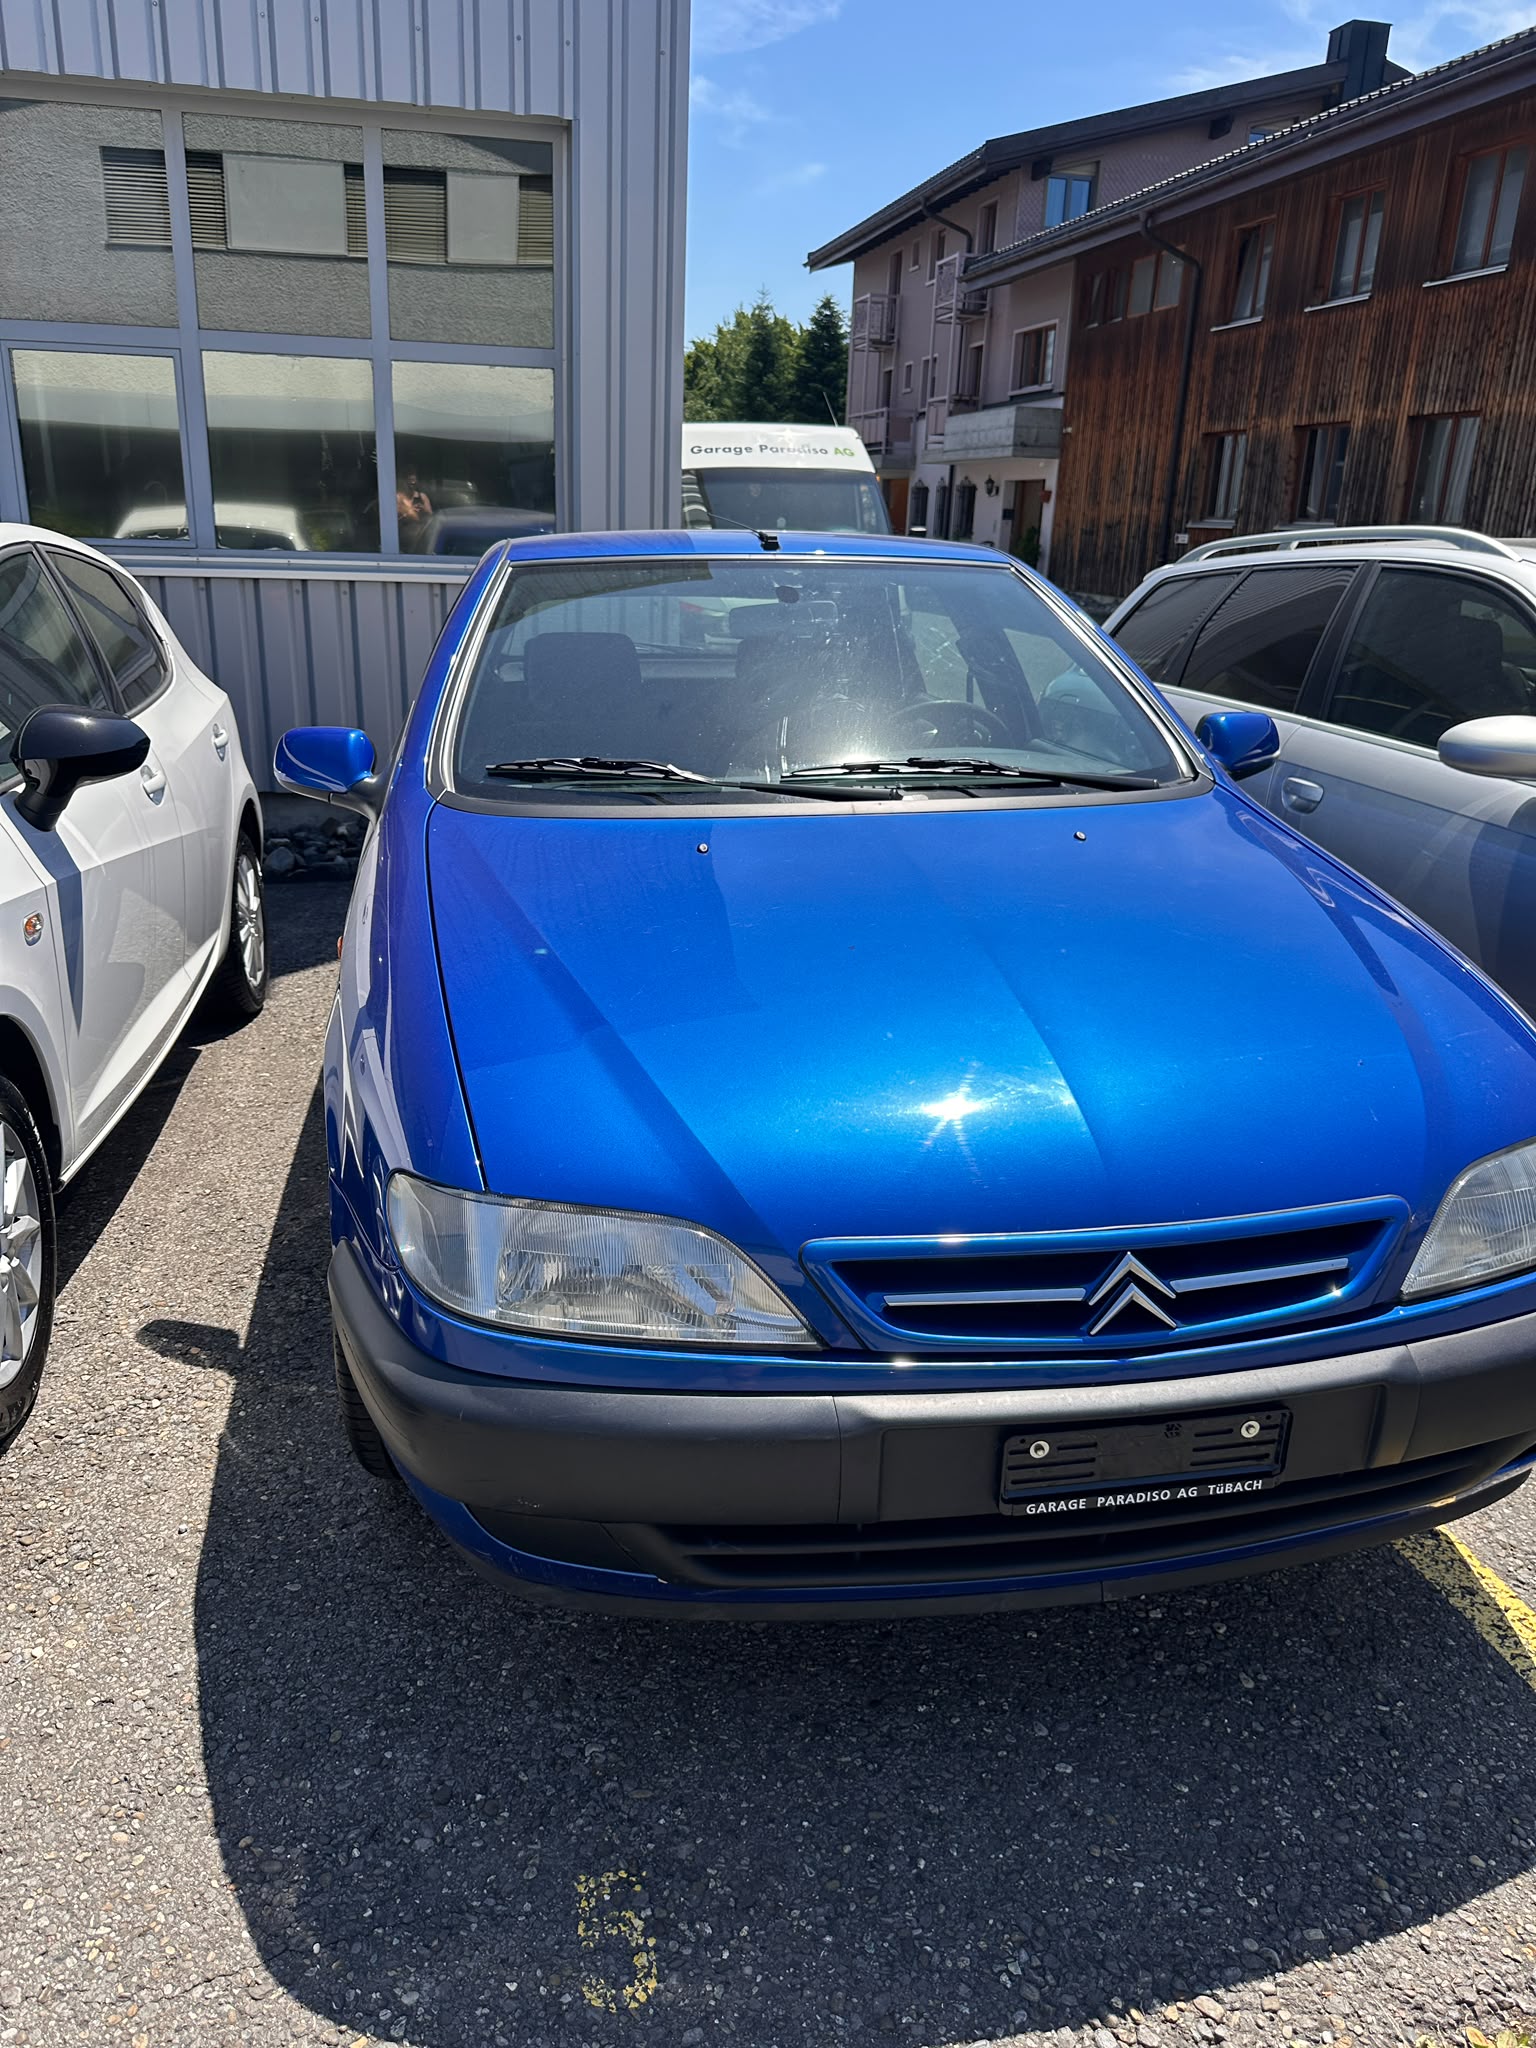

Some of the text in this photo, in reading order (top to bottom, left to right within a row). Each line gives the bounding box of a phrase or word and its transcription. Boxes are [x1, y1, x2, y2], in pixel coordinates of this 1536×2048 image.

[690, 445, 753, 455] Garage
[834, 447, 855, 457] AG
[1026, 1480, 1262, 1514] GARAGE PARADISO AG TüBACH
